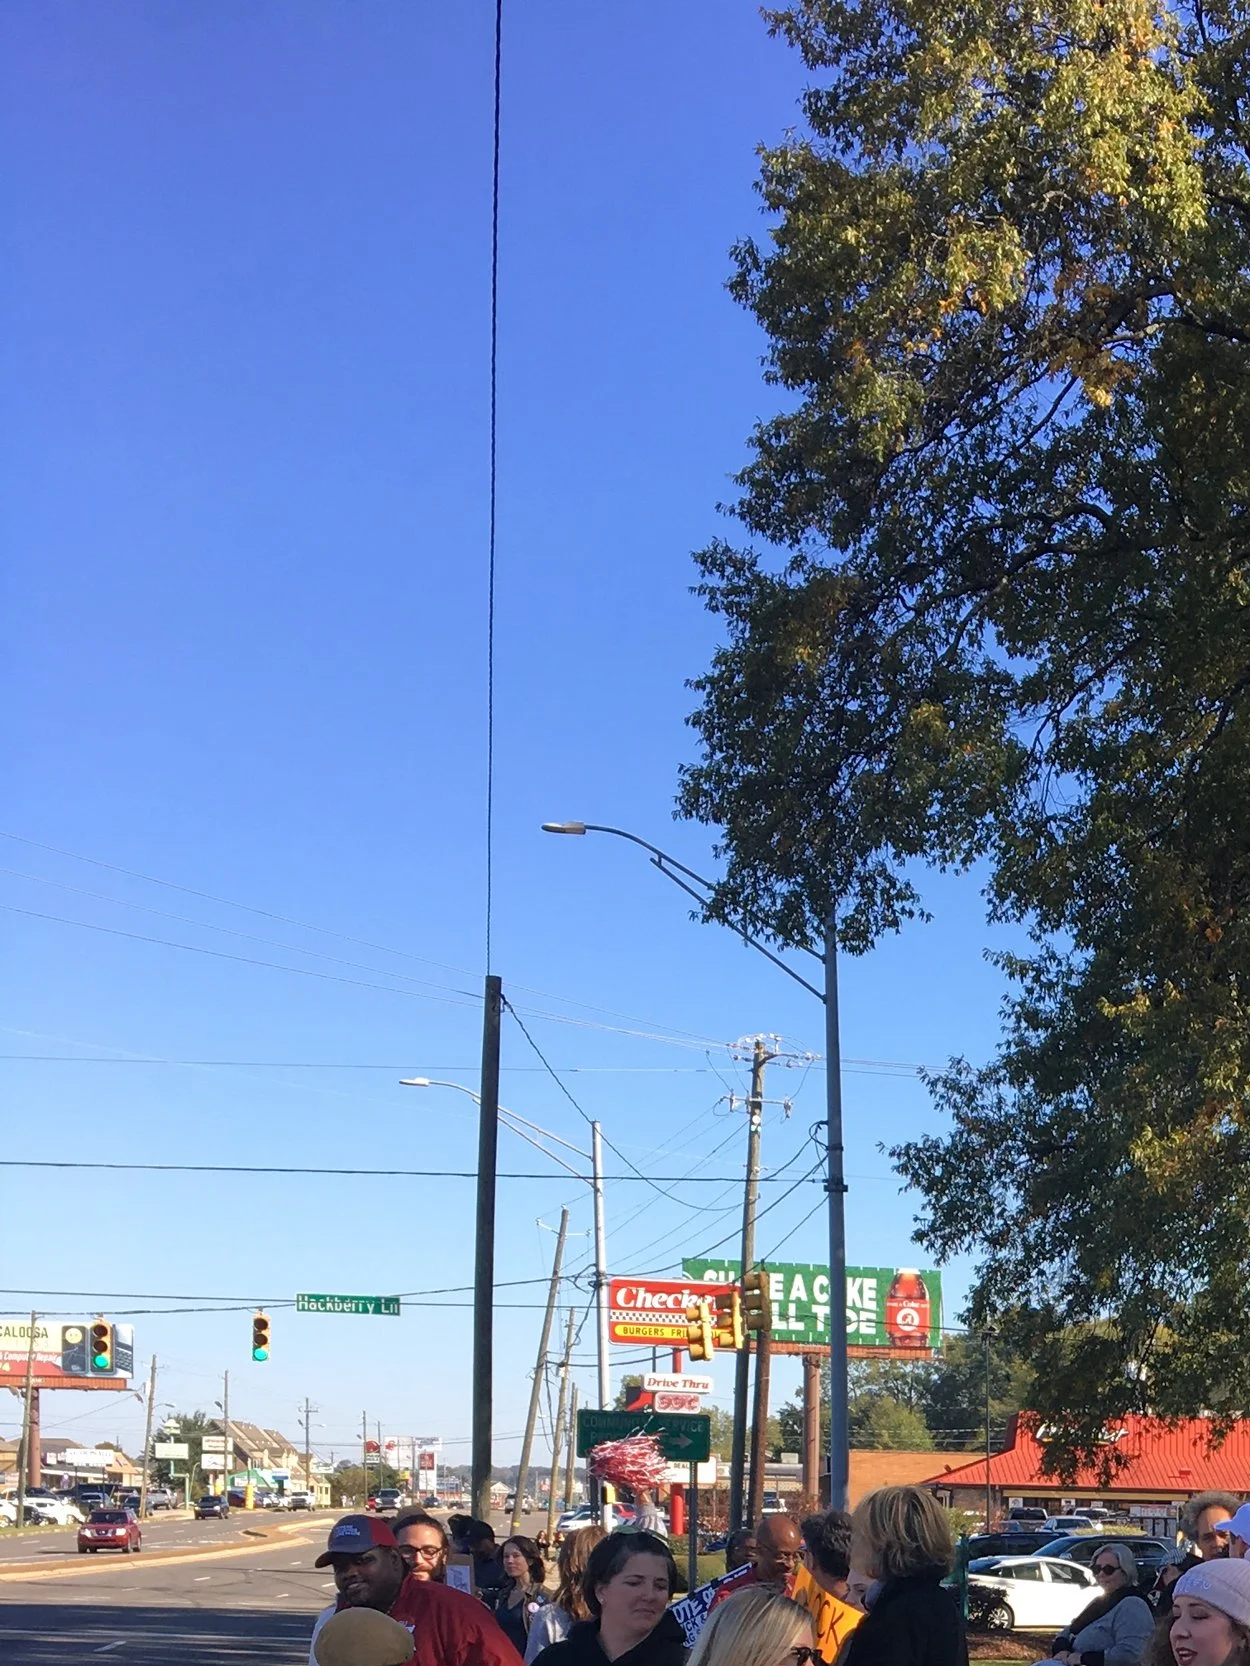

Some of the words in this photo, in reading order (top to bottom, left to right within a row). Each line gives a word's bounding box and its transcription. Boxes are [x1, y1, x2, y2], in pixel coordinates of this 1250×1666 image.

[789, 1273, 808, 1302] A
[812, 1274, 877, 1312] CKE
[298, 1295, 375, 1315] Hackberry
[381, 1298, 398, 1314] Ln
[811, 1304, 877, 1335] TDE
[622, 1326, 665, 1337] BURGERS
[647, 1377, 680, 1389] Drive
[681, 1379, 709, 1389] Thru
[672, 1598, 703, 1625] OTE
